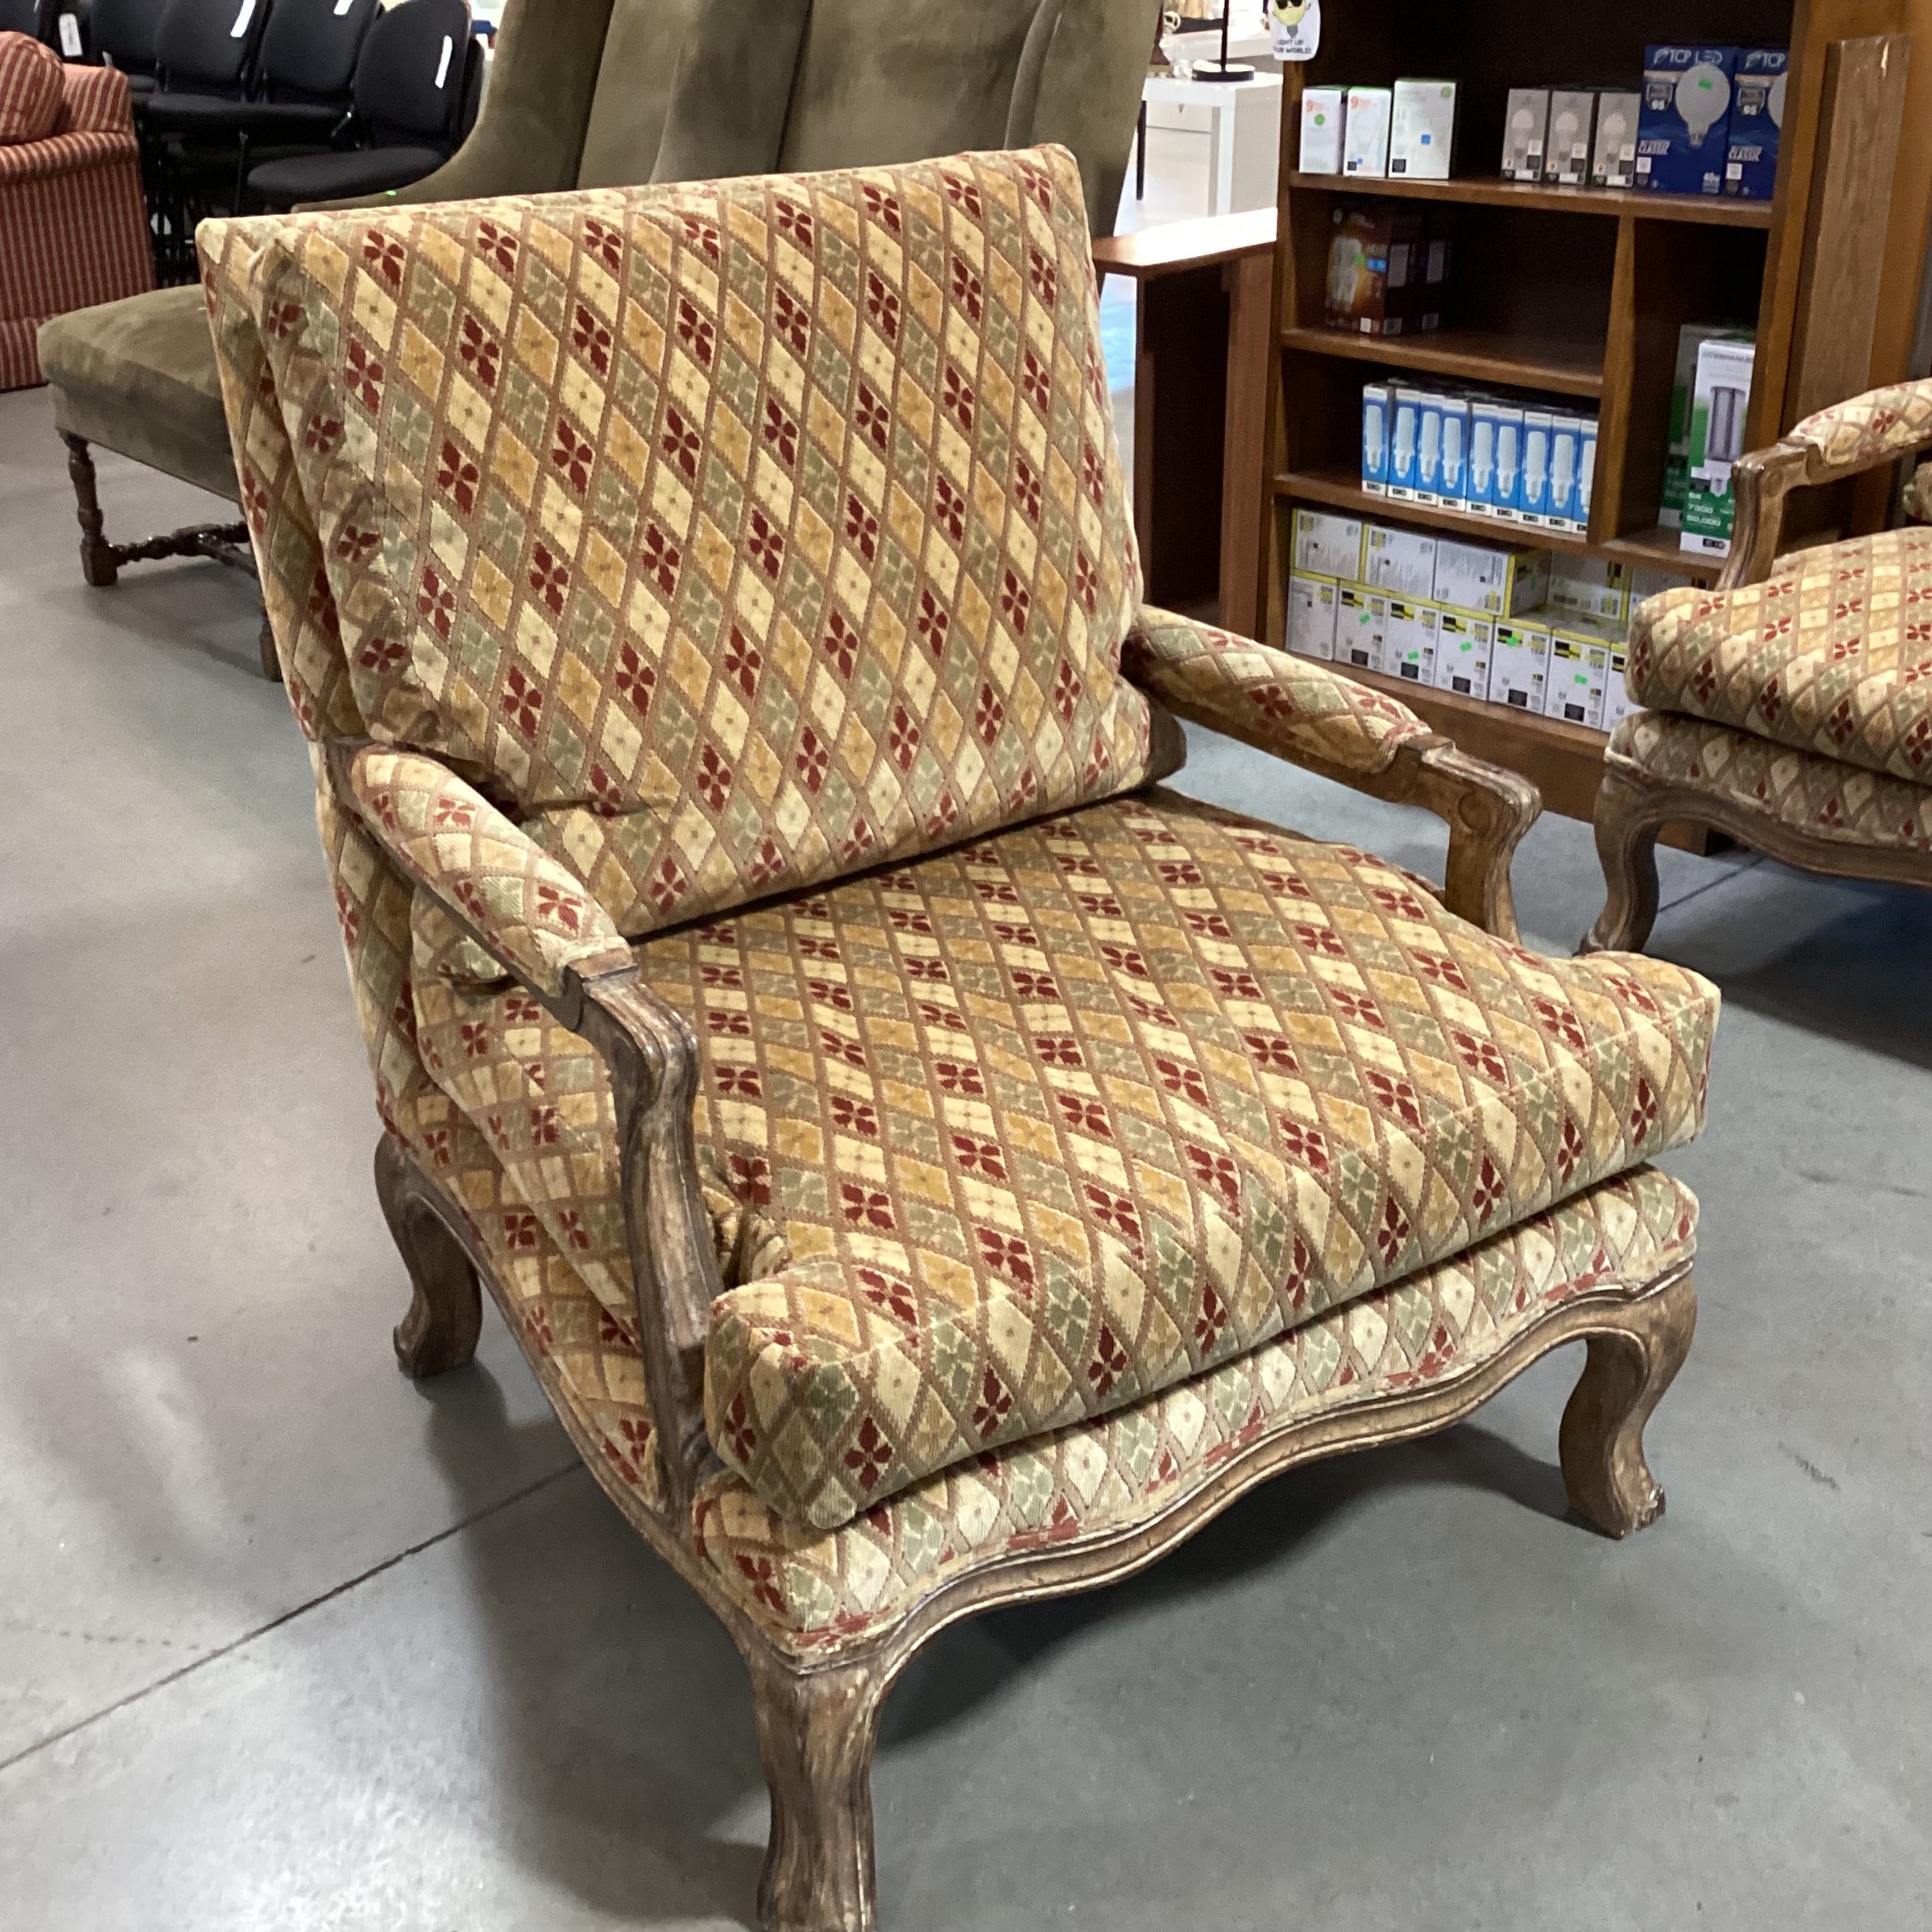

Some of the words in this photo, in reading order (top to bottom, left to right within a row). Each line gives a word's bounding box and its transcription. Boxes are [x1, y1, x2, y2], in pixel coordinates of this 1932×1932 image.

[1669, 50, 1692, 63] TCP
[1695, 51, 1723, 65] LED
[1638, 139, 1671, 155] CLASSIC
[1728, 145, 1762, 162] CLASSIC
